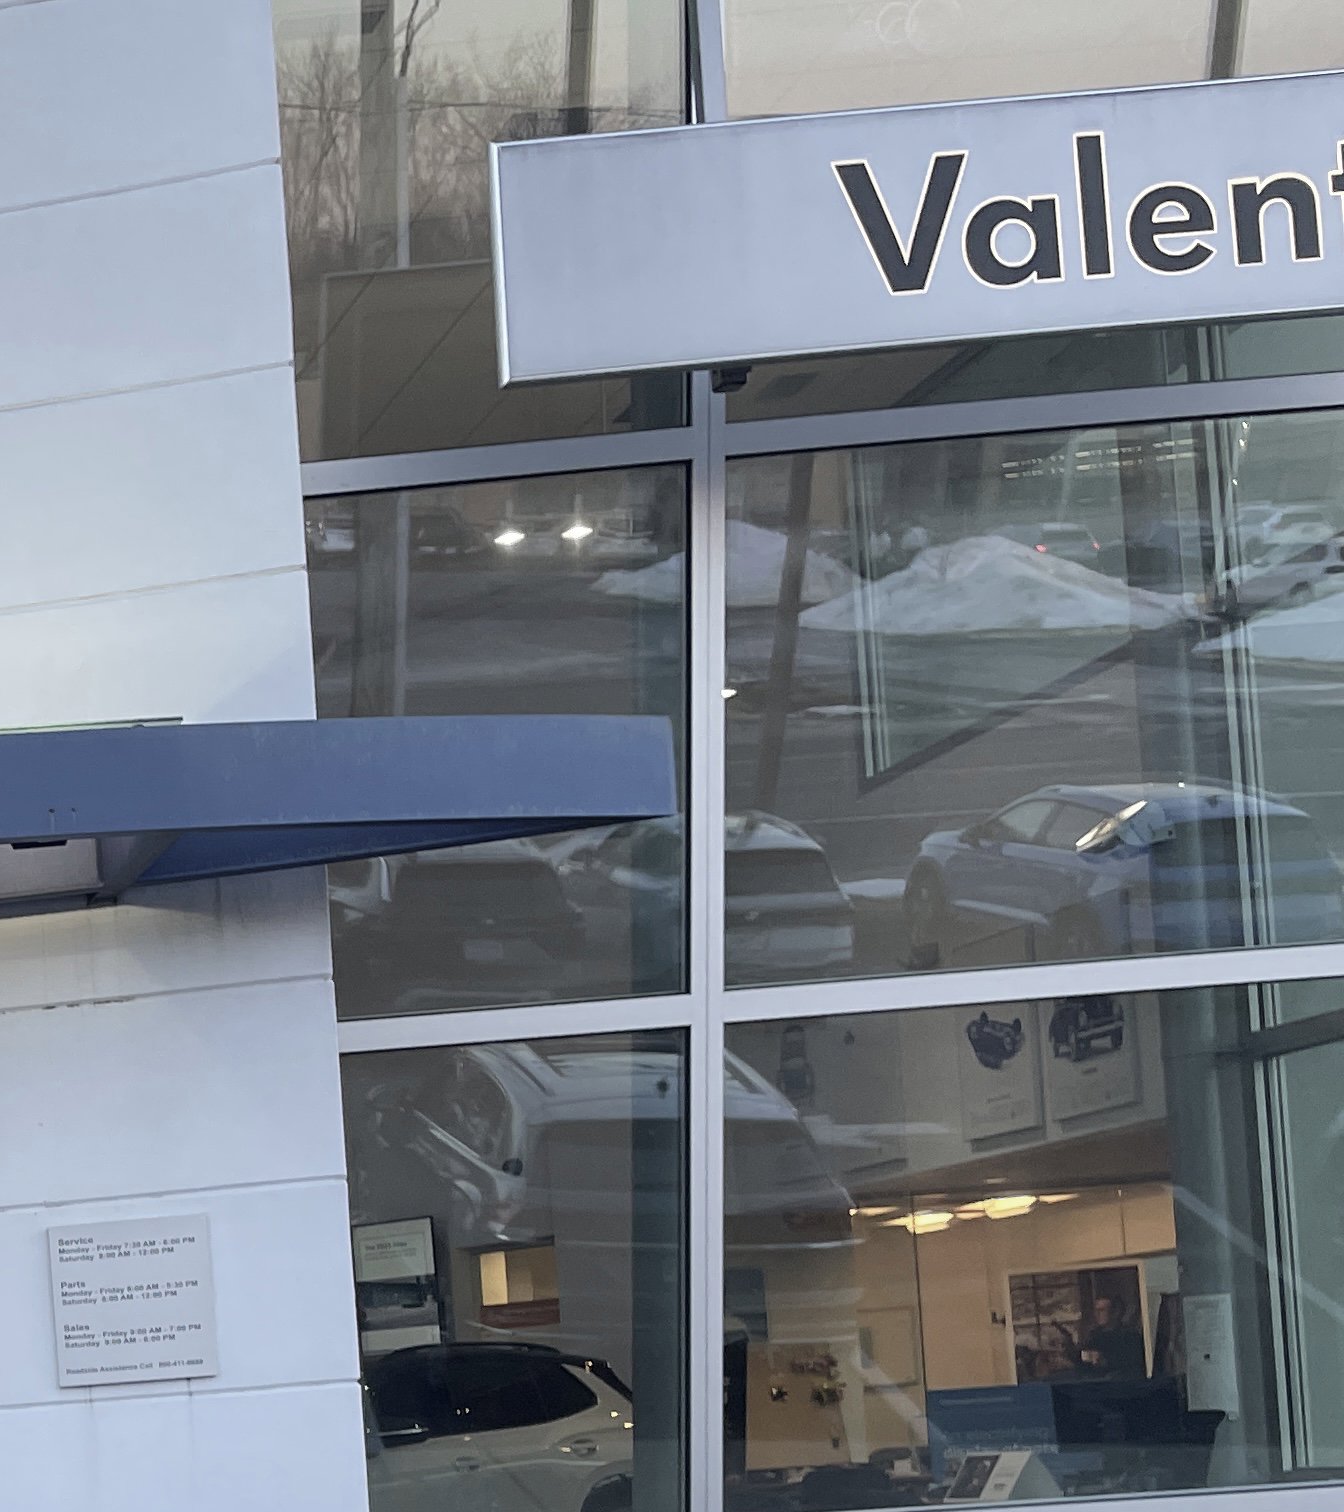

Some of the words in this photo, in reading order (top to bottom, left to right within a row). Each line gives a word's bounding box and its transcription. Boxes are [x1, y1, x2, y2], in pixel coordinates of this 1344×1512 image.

[58, 1237, 94, 1247] Service
[58, 1247, 90, 1256] Monday
[97, 1243, 122, 1253] Friday
[59, 1254, 94, 1263] Saturday
[60, 1281, 86, 1289] Parts
[61, 1289, 93, 1298] Monday
[100, 1286, 124, 1295] Friday
[185, 1279, 199, 1287] PM
[62, 1298, 98, 1306] Saturday
[63, 1324, 90, 1332] Sales
[64, 1333, 96, 1341] Monday
[102, 1330, 128, 1338] Friday
[189, 1323, 202, 1331] PM
[64, 1341, 100, 1349] Saturday
